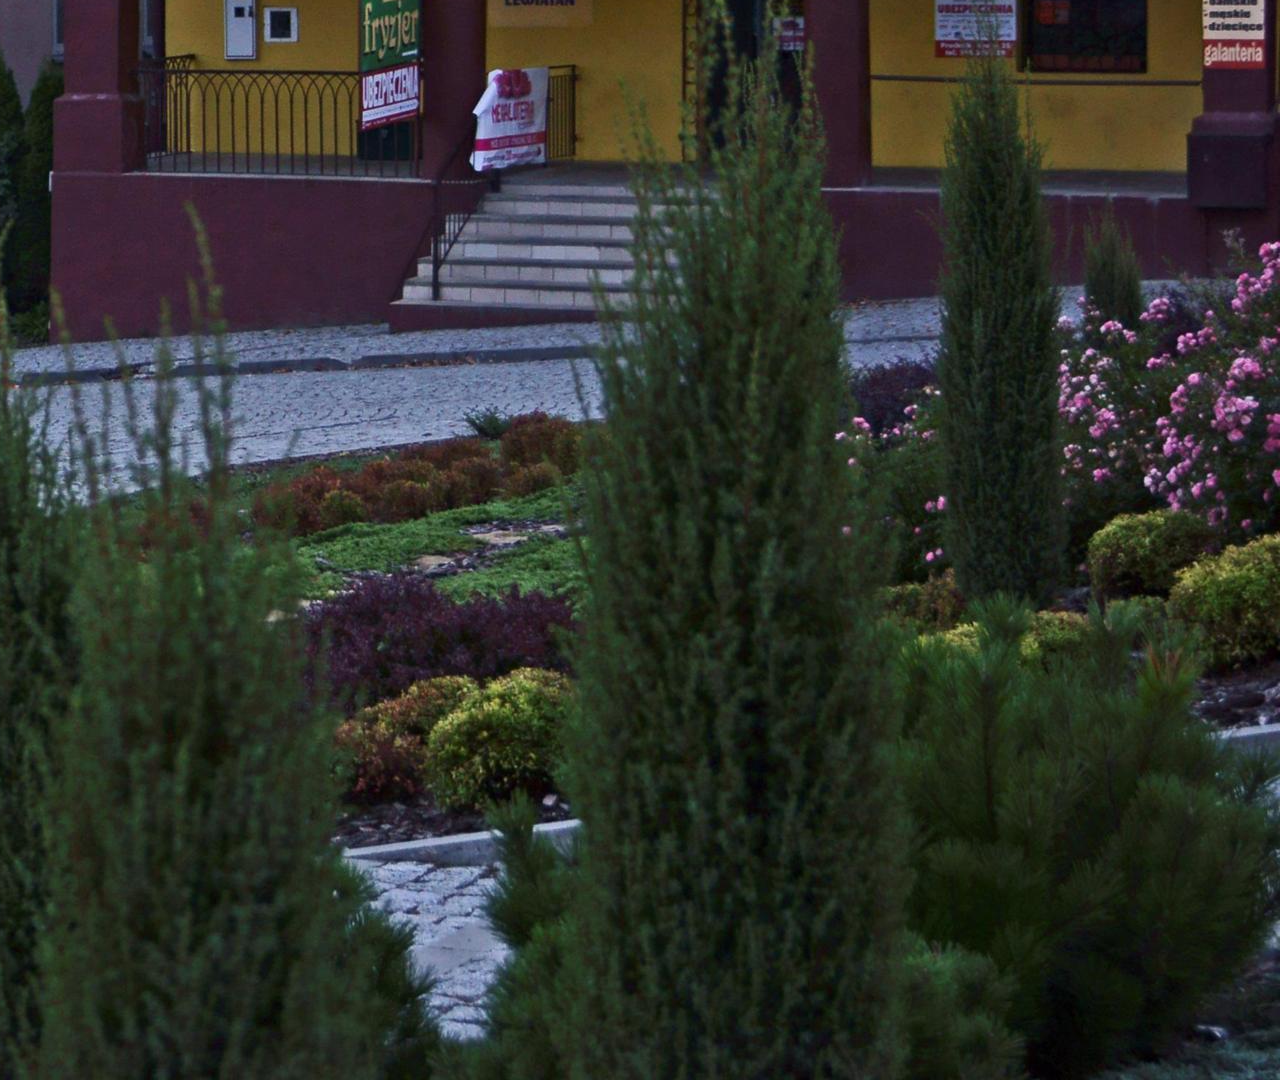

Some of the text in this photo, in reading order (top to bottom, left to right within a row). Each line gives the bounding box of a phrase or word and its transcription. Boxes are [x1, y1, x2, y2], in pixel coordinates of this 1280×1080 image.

[1208, 21, 1263, 31] dziecięce
[1209, 9, 1251, 19] męskie
[362, 0, 419, 59] fryzjer
[1204, 41, 1263, 66] galanteria
[362, 65, 419, 109] UBEZPIECZENIA
